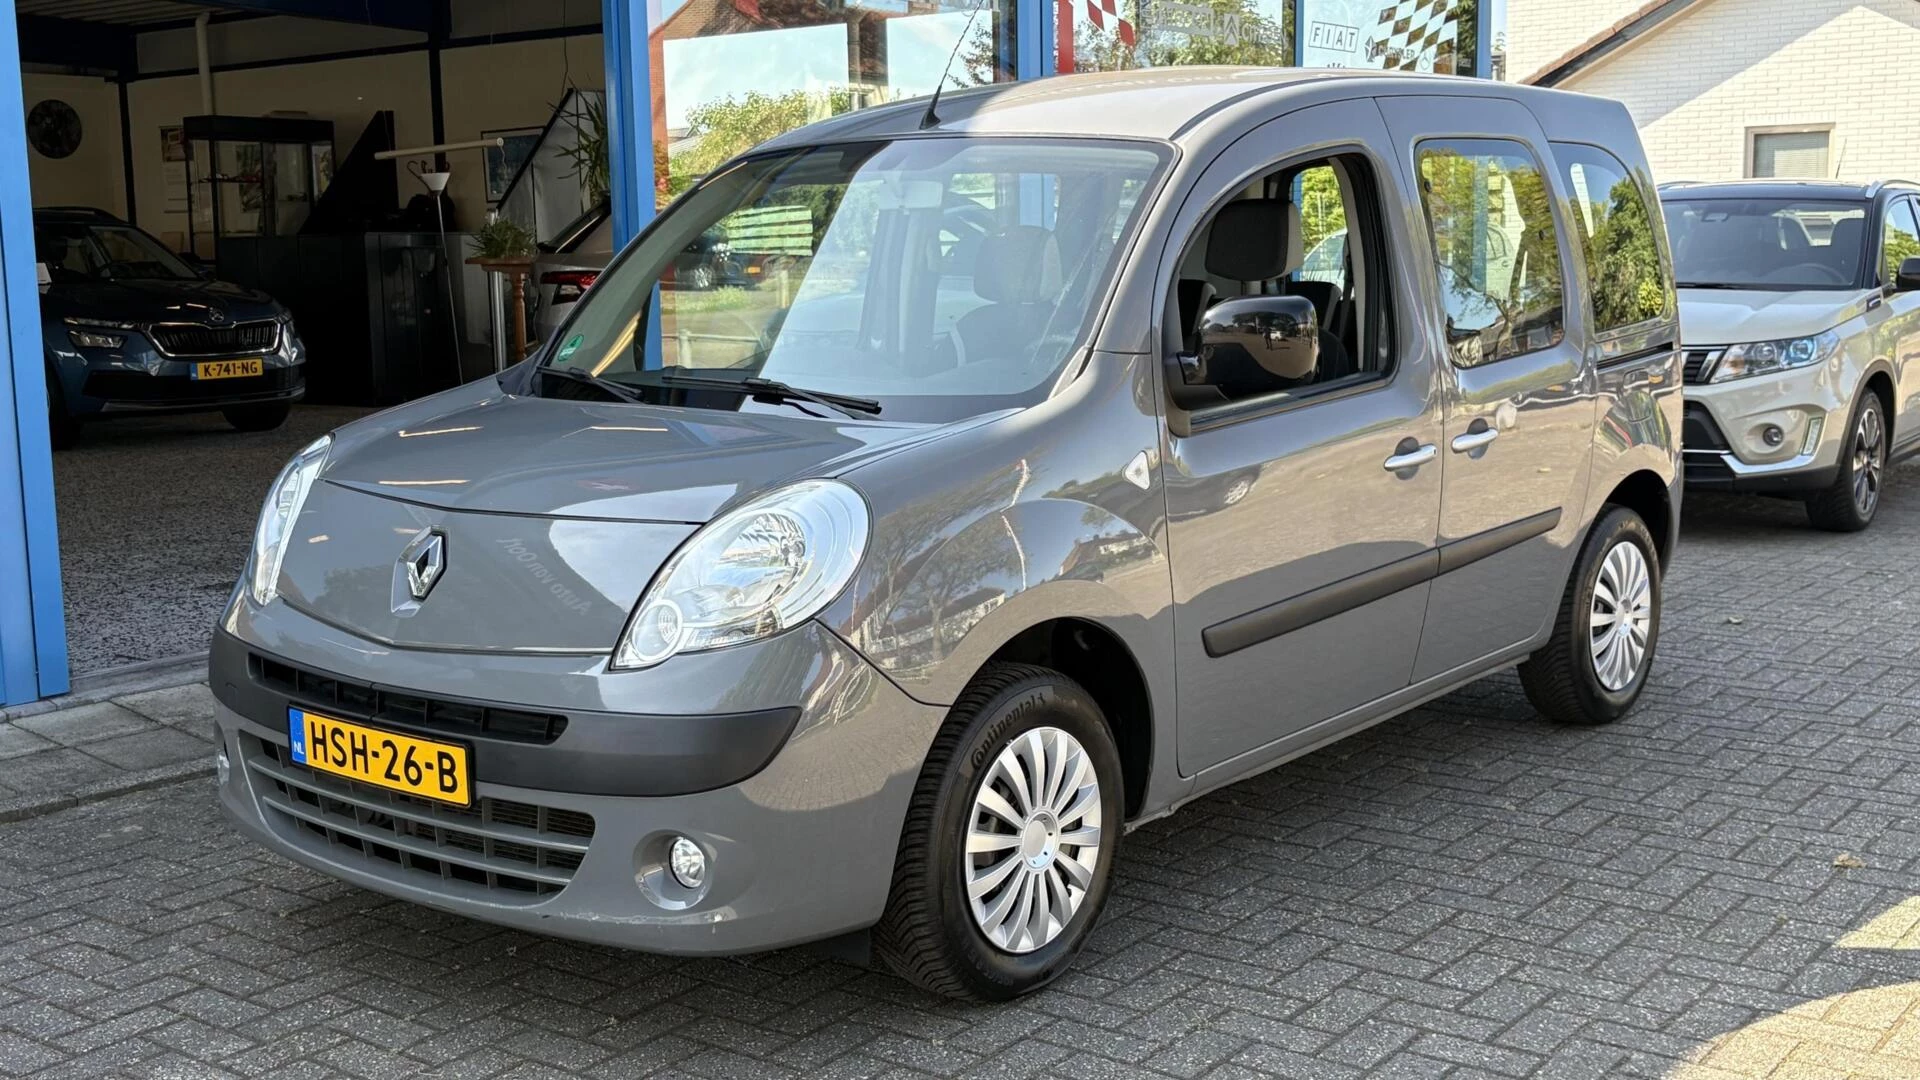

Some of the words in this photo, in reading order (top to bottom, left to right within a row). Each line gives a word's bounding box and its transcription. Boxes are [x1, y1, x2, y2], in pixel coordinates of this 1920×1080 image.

[1312, 27, 1356, 49] FIAT
[204, 361, 258, 377] K-741-NG
[971, 695, 1036, 770] Continental
[293, 741, 305, 755] NL
[311, 721, 458, 793] HSH-26-B
